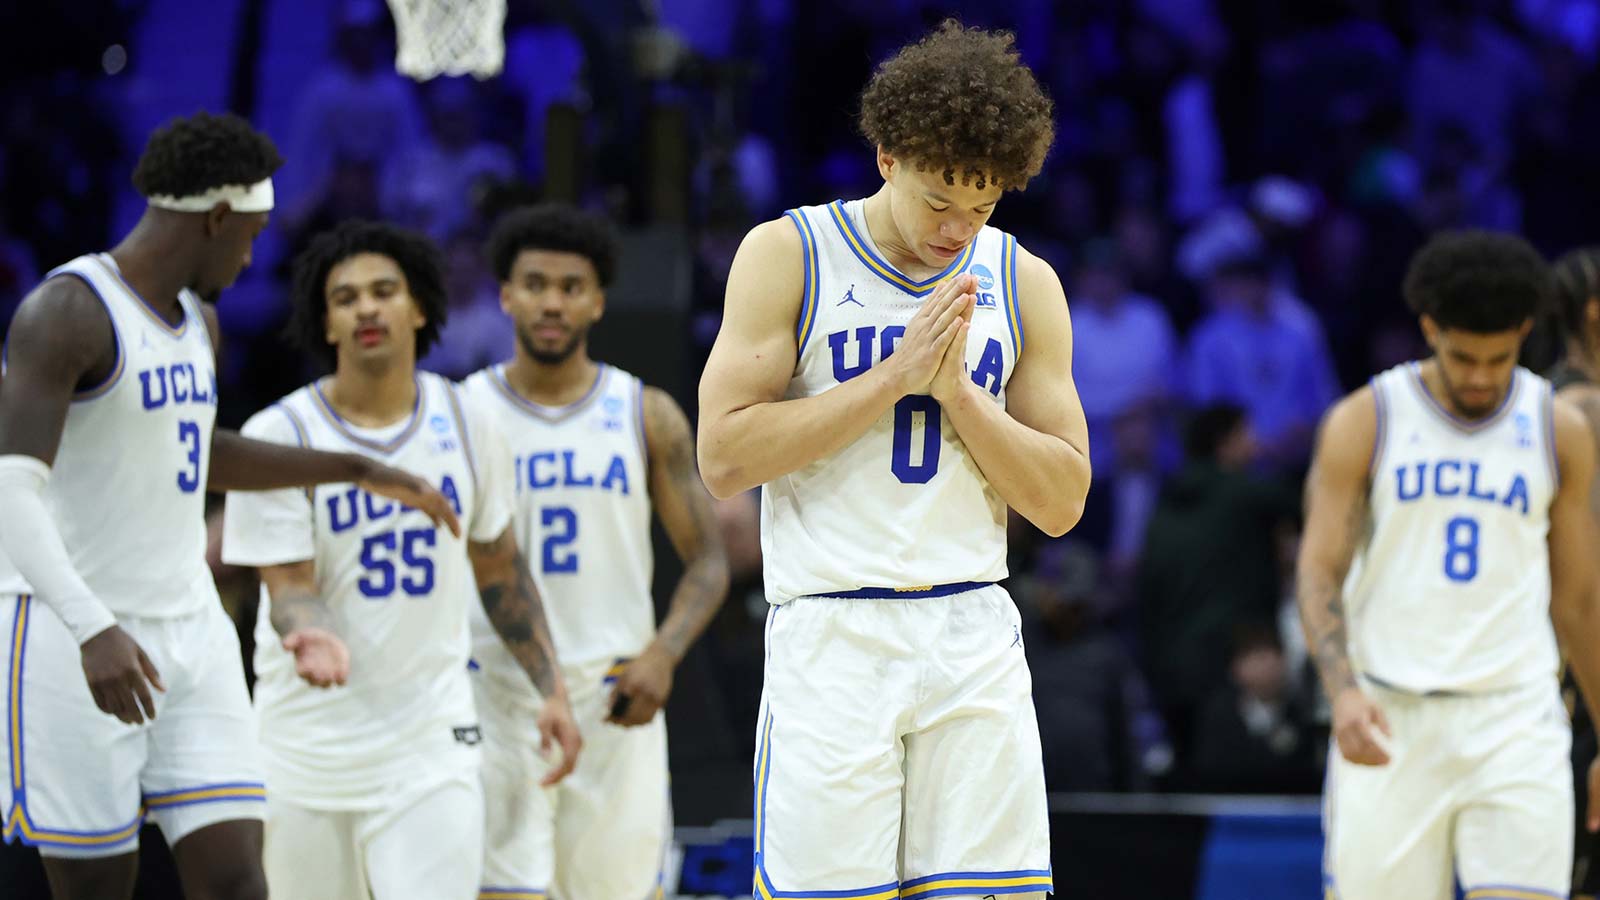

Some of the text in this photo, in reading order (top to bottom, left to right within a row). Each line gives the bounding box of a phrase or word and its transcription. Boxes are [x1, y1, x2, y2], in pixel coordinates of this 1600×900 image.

[828, 325, 1004, 398] UCA
[177, 420, 200, 493] 3
[891, 394, 941, 484] 0
[327, 476, 462, 533] UCA
[1397, 460, 1528, 514] UCLA
[358, 527, 436, 597] 55
[541, 506, 578, 574] 2
[1445, 517, 1479, 582] 8
